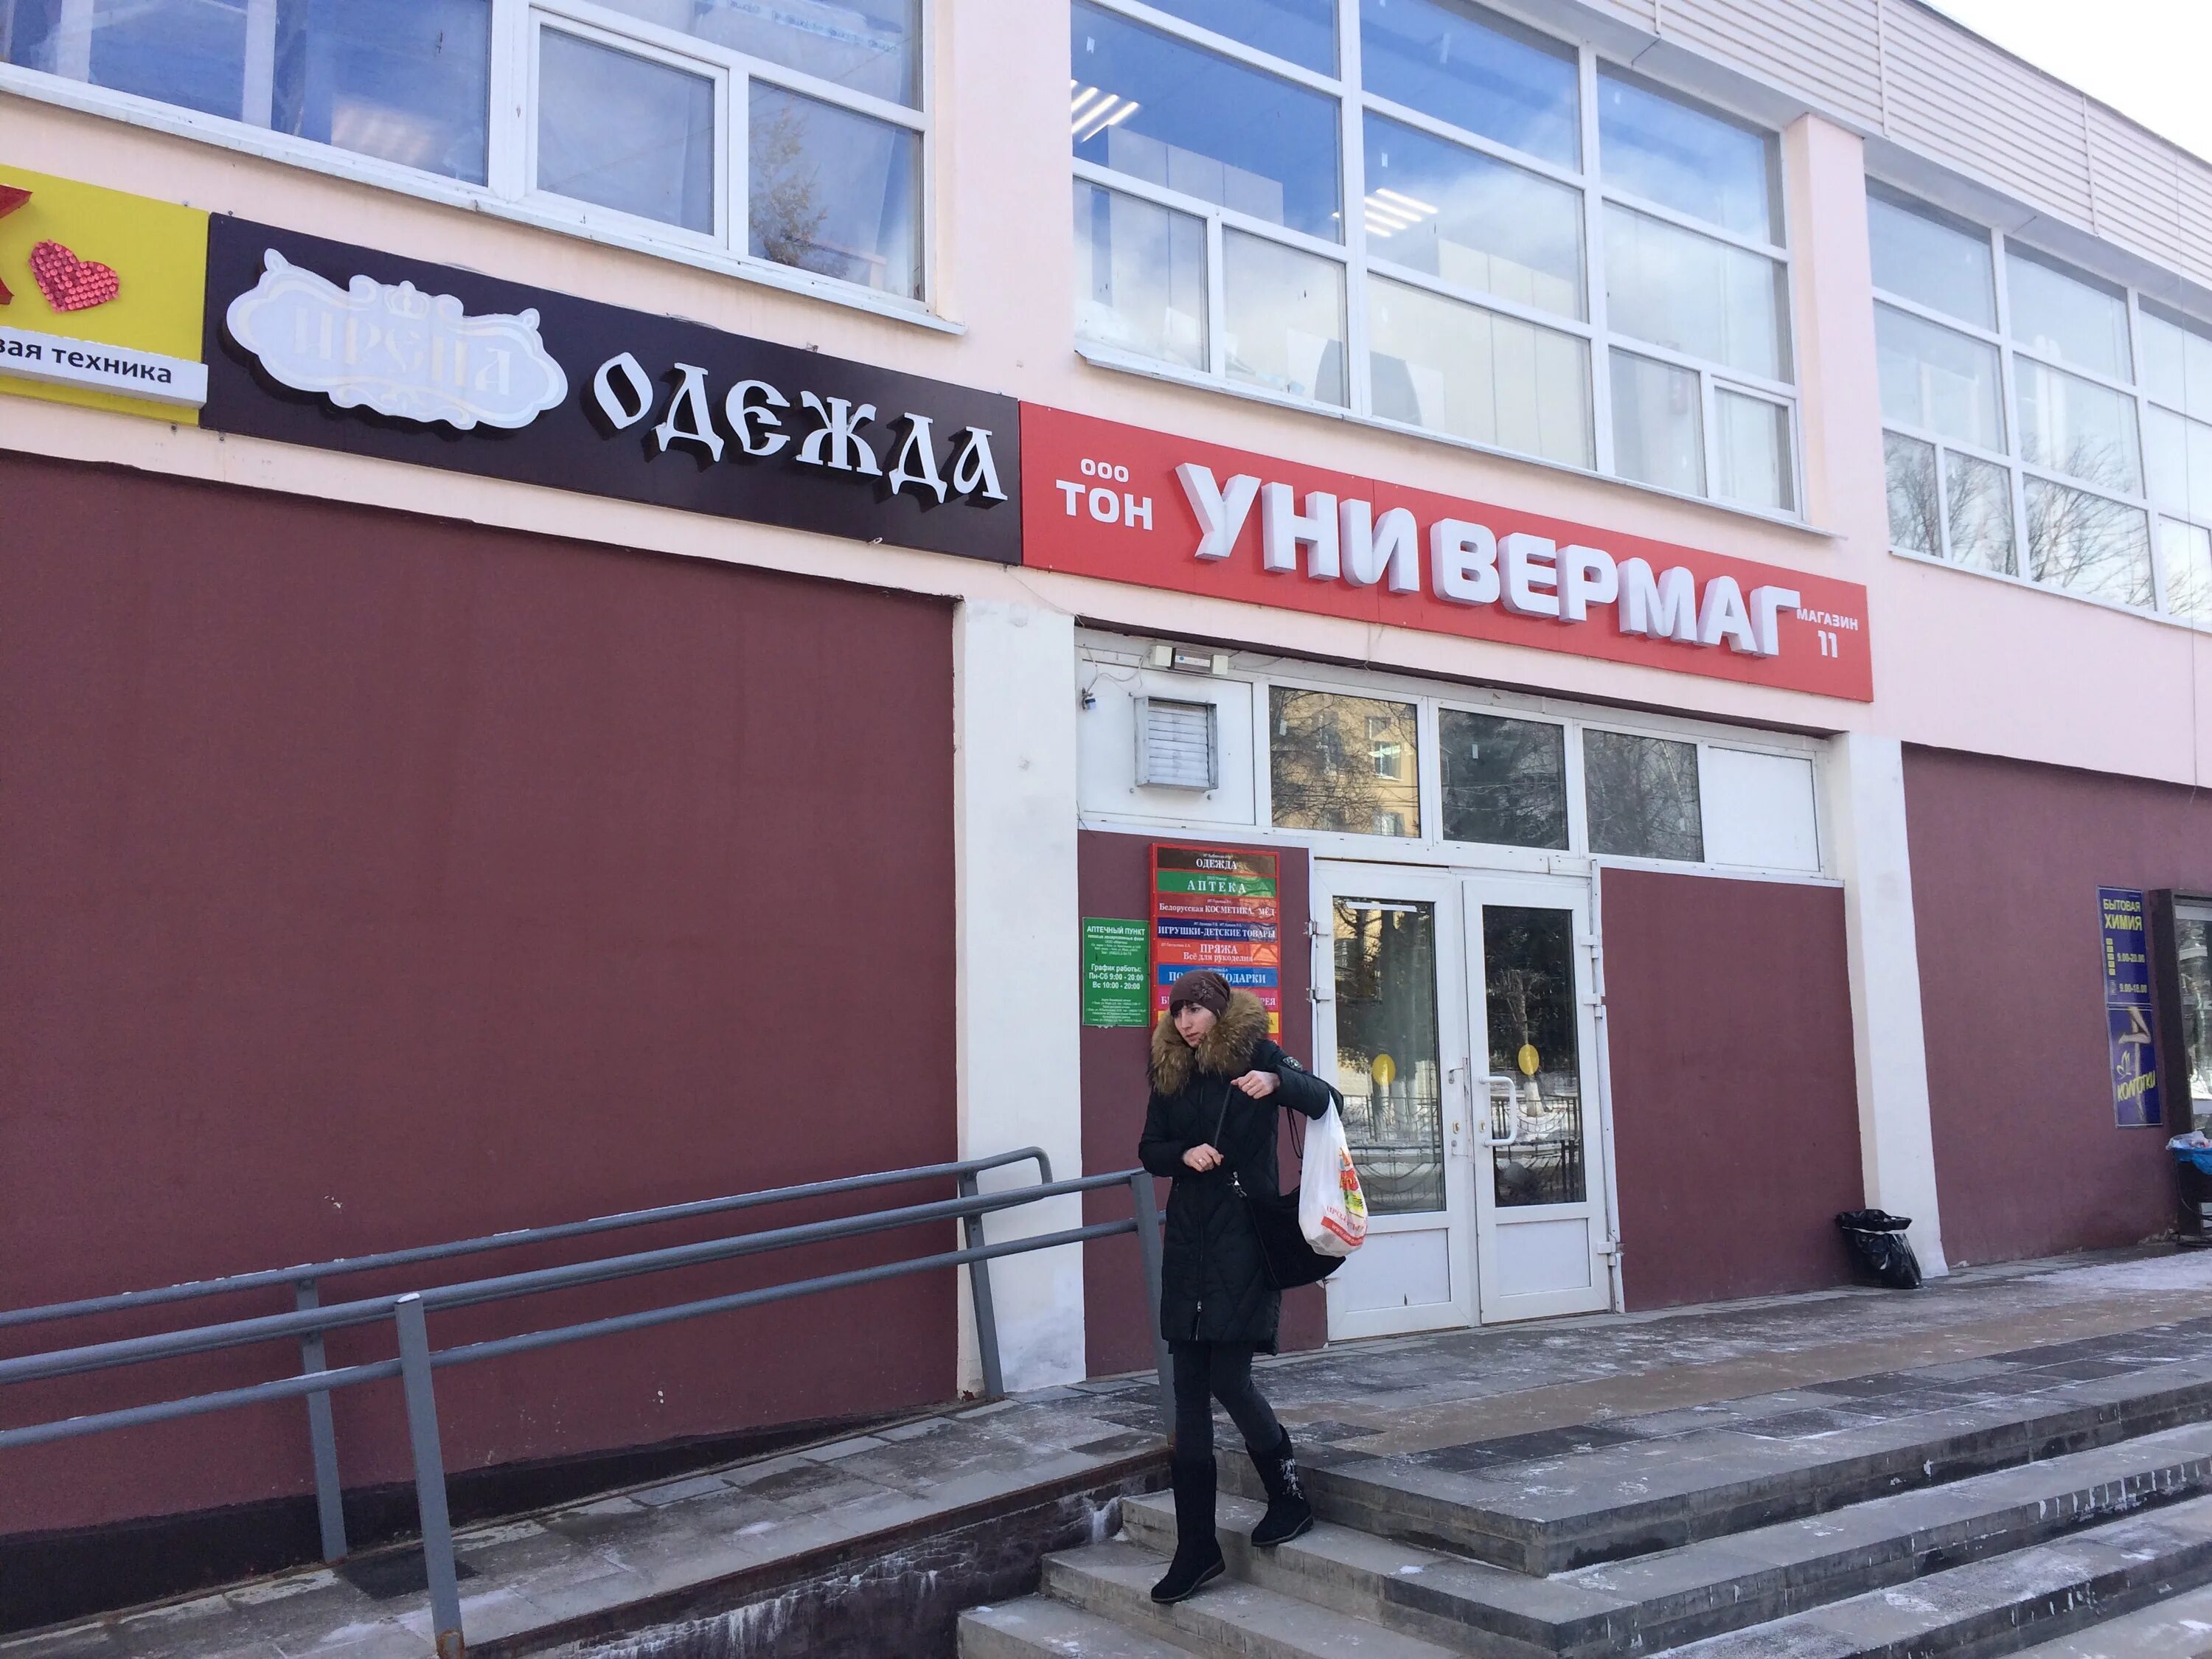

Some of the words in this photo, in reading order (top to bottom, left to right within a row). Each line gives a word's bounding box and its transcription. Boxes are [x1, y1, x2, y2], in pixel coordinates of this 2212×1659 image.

[52, 348, 172, 383] техника
[594, 352, 1008, 504] ОДЕЖДА
[1081, 458, 1129, 483] ООО
[1056, 479, 1154, 531] ТОН
[1175, 462, 1801, 658] УНИВЕРМАГ
[1796, 608, 1858, 631] МАГАЗИН
[1818, 630, 1838, 658] 11
[1195, 858, 1237, 870] ОДЕЖДА
[1187, 880, 1247, 894] АПТЕКА
[1159, 902, 1204, 913] Белорусская
[2103, 898, 2141, 913] БЫТОВАЯ
[2104, 914, 2143, 931] ХИМИЯ
[1087, 925, 1124, 934] АПТЕЧНЫЙ
[1124, 928, 1145, 936] ПУНКТ
[1158, 925, 1241, 937] ИГРУШКИ-ДЕТСКИЕ
[1242, 929, 1276, 938] ТОВАРЫ
[1200, 943, 1238, 955] ПРЯЖА
[1183, 952, 1197, 961] Всё
[1214, 953, 1253, 963] рукоделия
[1091, 963, 1116, 973] График
[1088, 972, 1108, 980] Пн-Сб
